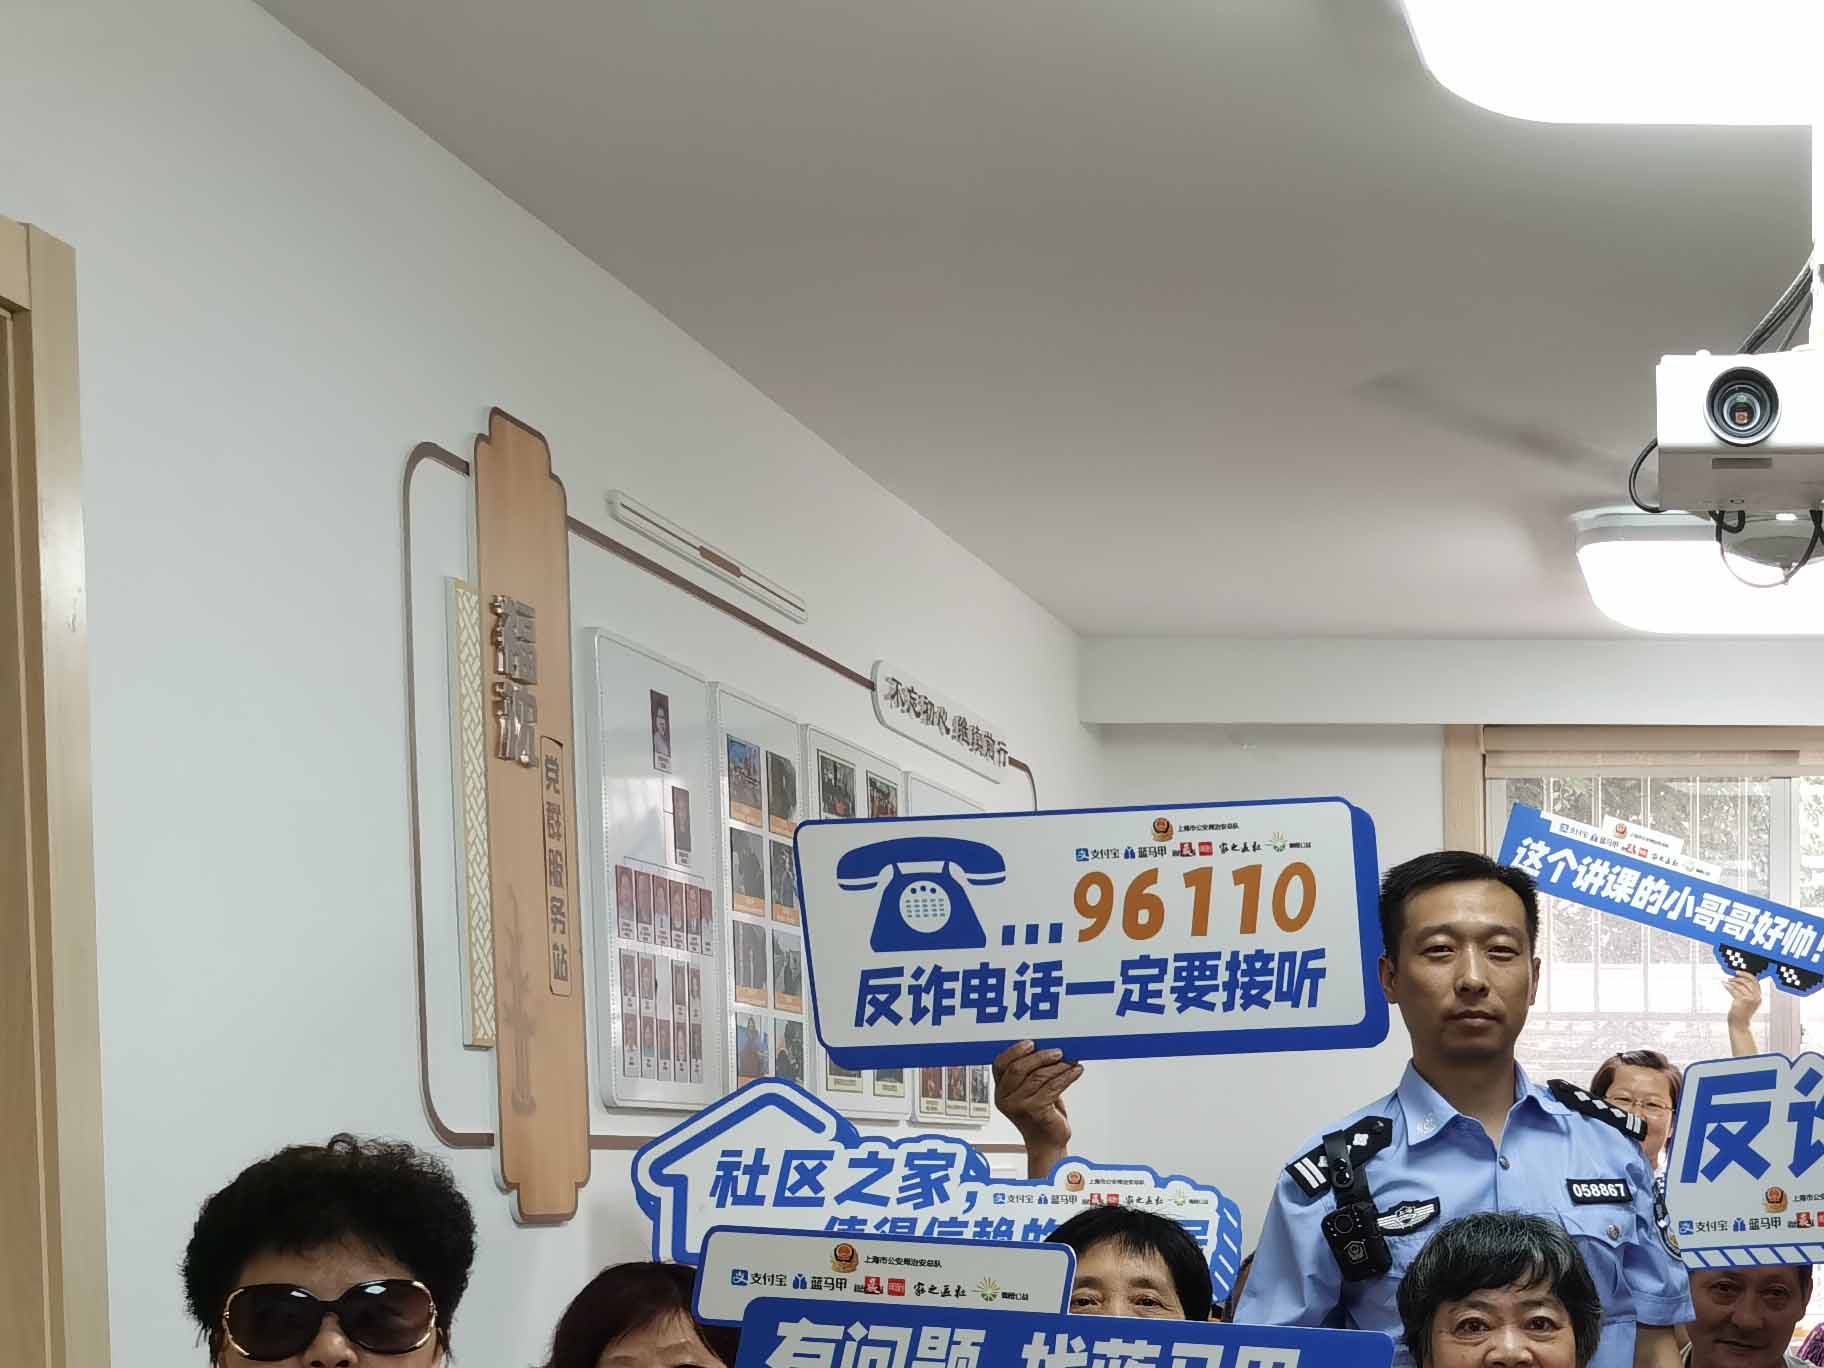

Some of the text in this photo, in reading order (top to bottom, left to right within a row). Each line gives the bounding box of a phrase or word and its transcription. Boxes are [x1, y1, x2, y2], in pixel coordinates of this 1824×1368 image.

[544, 754, 569, 981] 党群服务站
[1074, 862, 1317, 942] 96110
[854, 948, 1327, 1028] 反诈电话一定要接听
[1572, 1182, 1626, 1200] 058867
[1695, 1219, 1729, 1233] 支付宝
[1749, 1217, 1782, 1231] 蓝马甲
[750, 1272, 788, 1288] 支付宝
[810, 1275, 848, 1291] 蓝马甲
